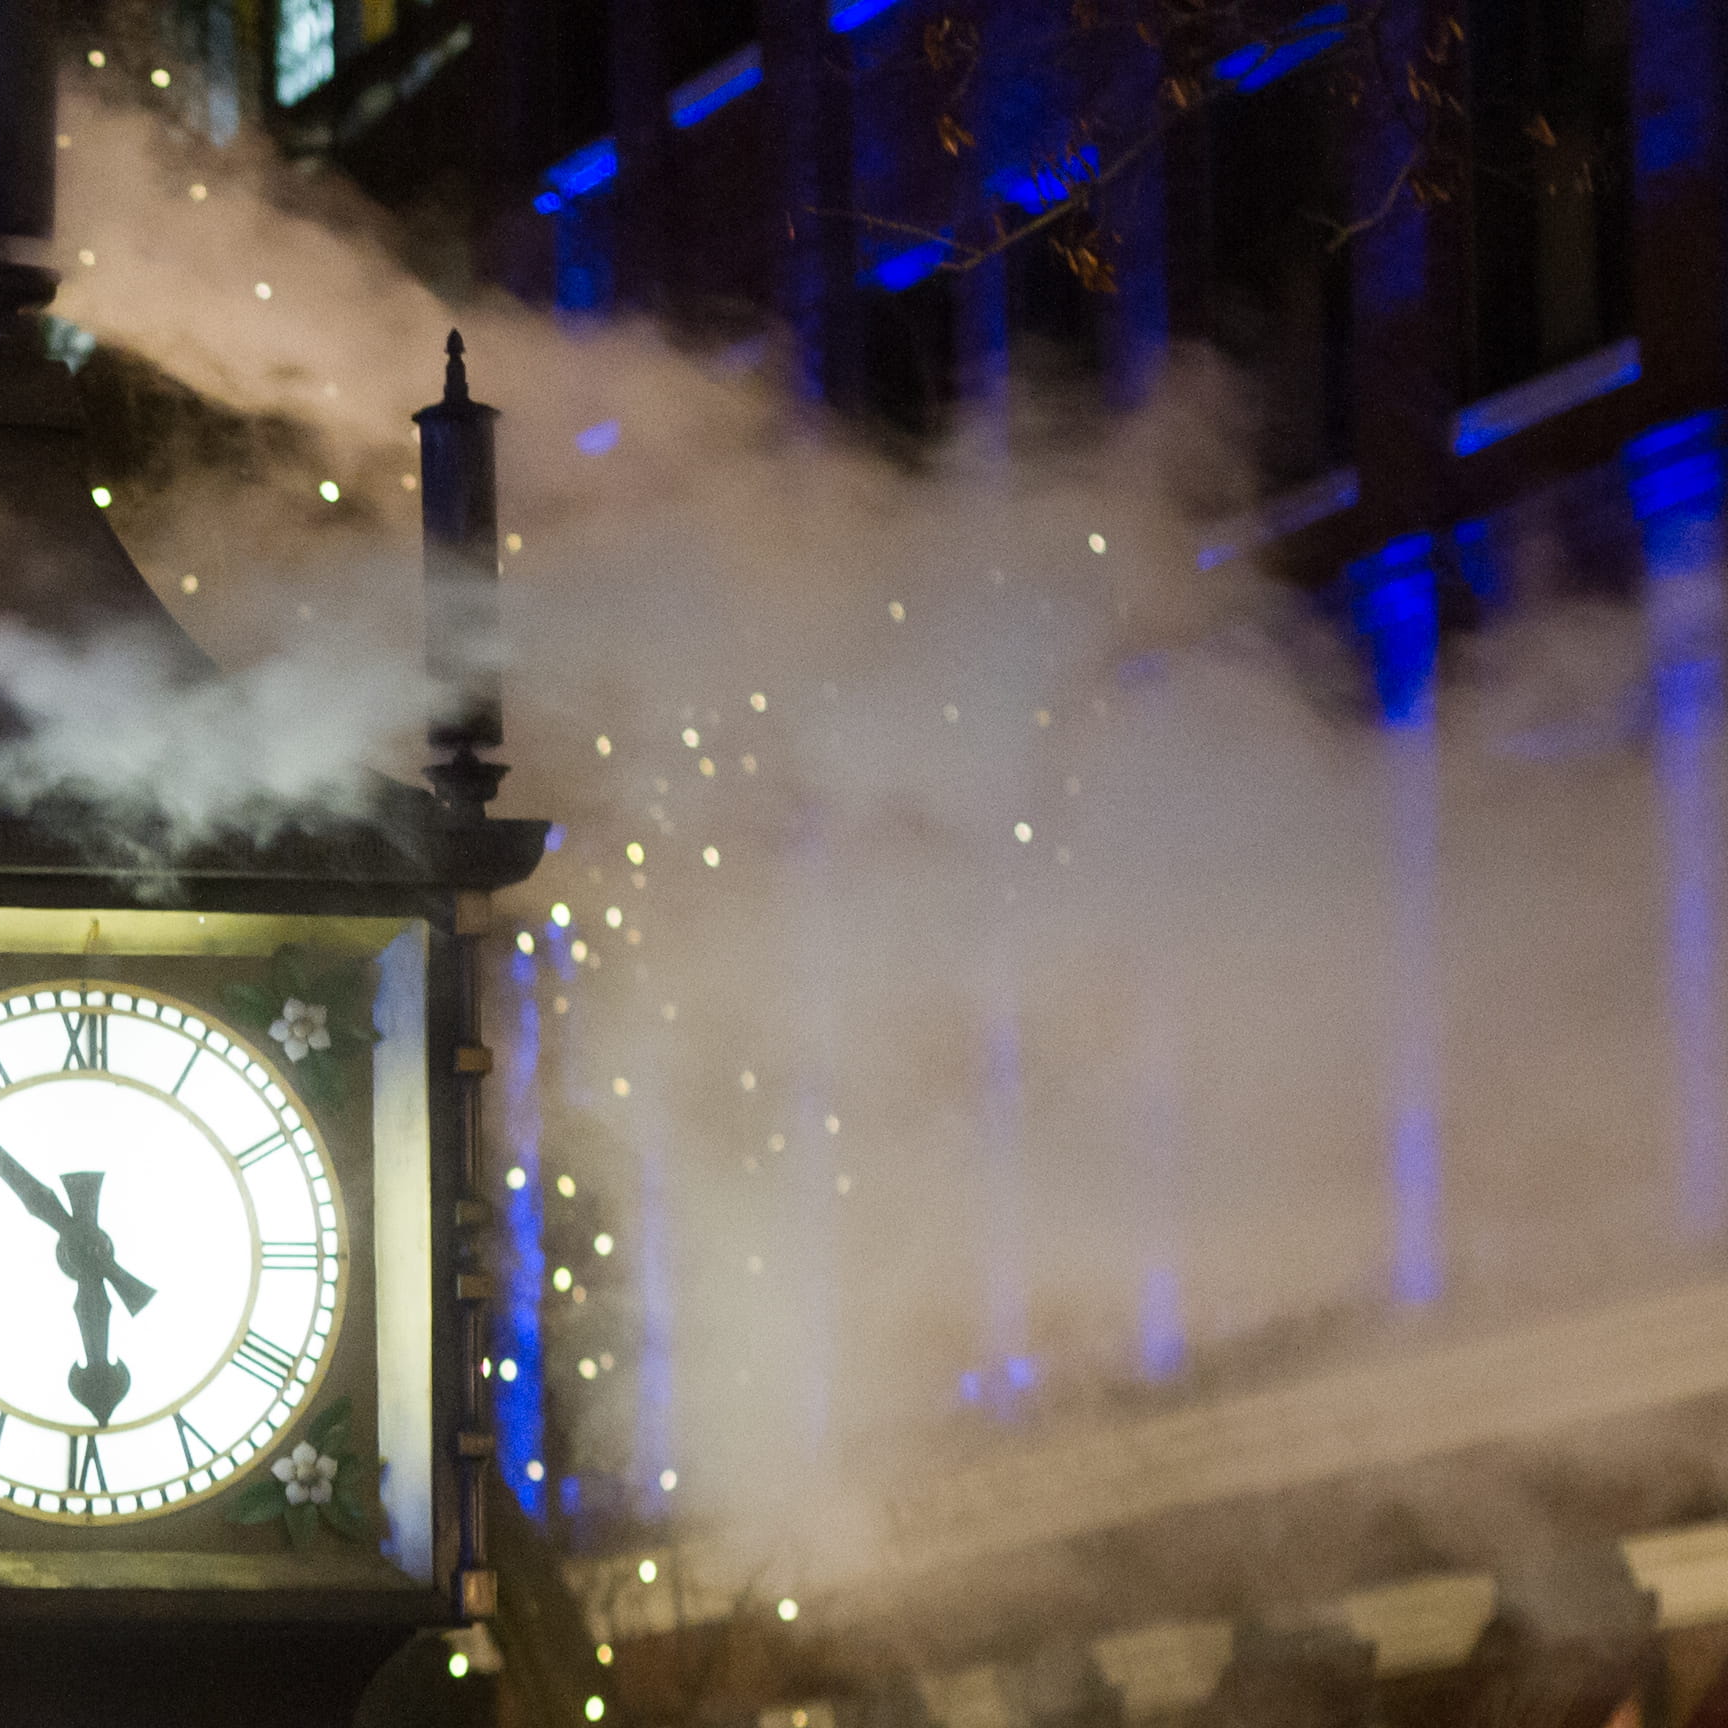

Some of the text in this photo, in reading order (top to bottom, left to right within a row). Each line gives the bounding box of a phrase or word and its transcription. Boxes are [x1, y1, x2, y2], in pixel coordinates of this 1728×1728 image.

[62, 1012, 108, 1071] XII
[172, 1044, 202, 1096] I
[234, 1130, 289, 1169] II
[260, 1241, 318, 1270] III
[230, 1330, 299, 1391] IIII
[68, 1435, 108, 1493] VI
[174, 1412, 218, 1470] V
